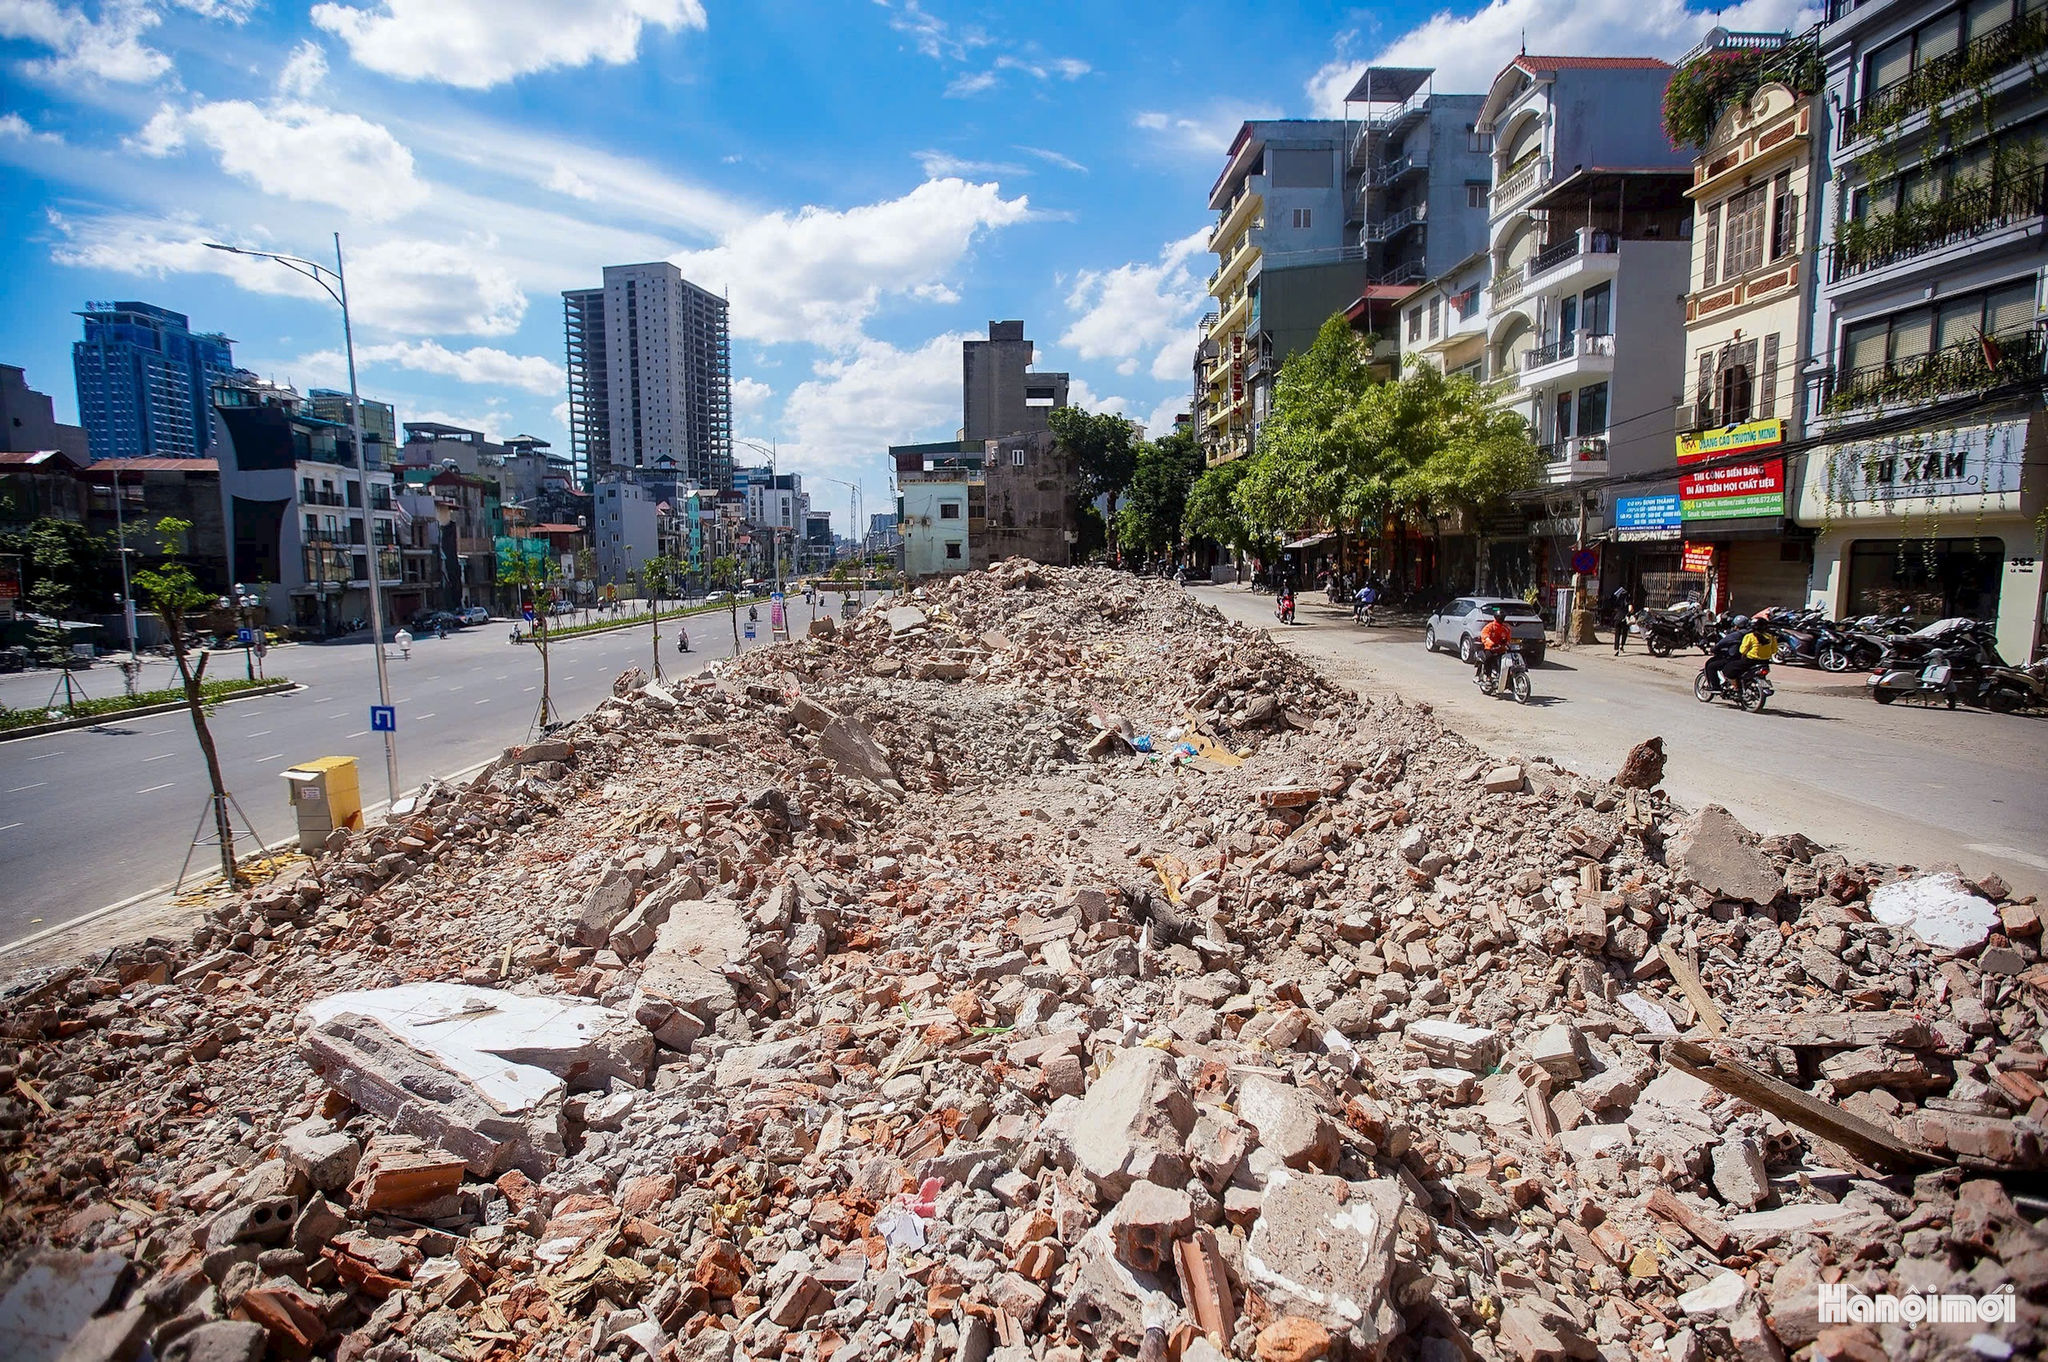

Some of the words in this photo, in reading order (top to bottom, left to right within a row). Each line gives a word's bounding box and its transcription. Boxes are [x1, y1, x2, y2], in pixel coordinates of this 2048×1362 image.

[1693, 472, 1705, 482] THI
[1705, 469, 1726, 481] CÔNG
[1686, 485, 1694, 495] IN
[1705, 482, 1722, 493] TRÊN
[1723, 481, 1738, 493] MỌI
[1738, 477, 1758, 491] CHẤT
[1758, 476, 1776, 489] LIỆU
[2011, 557, 2034, 567] 362
